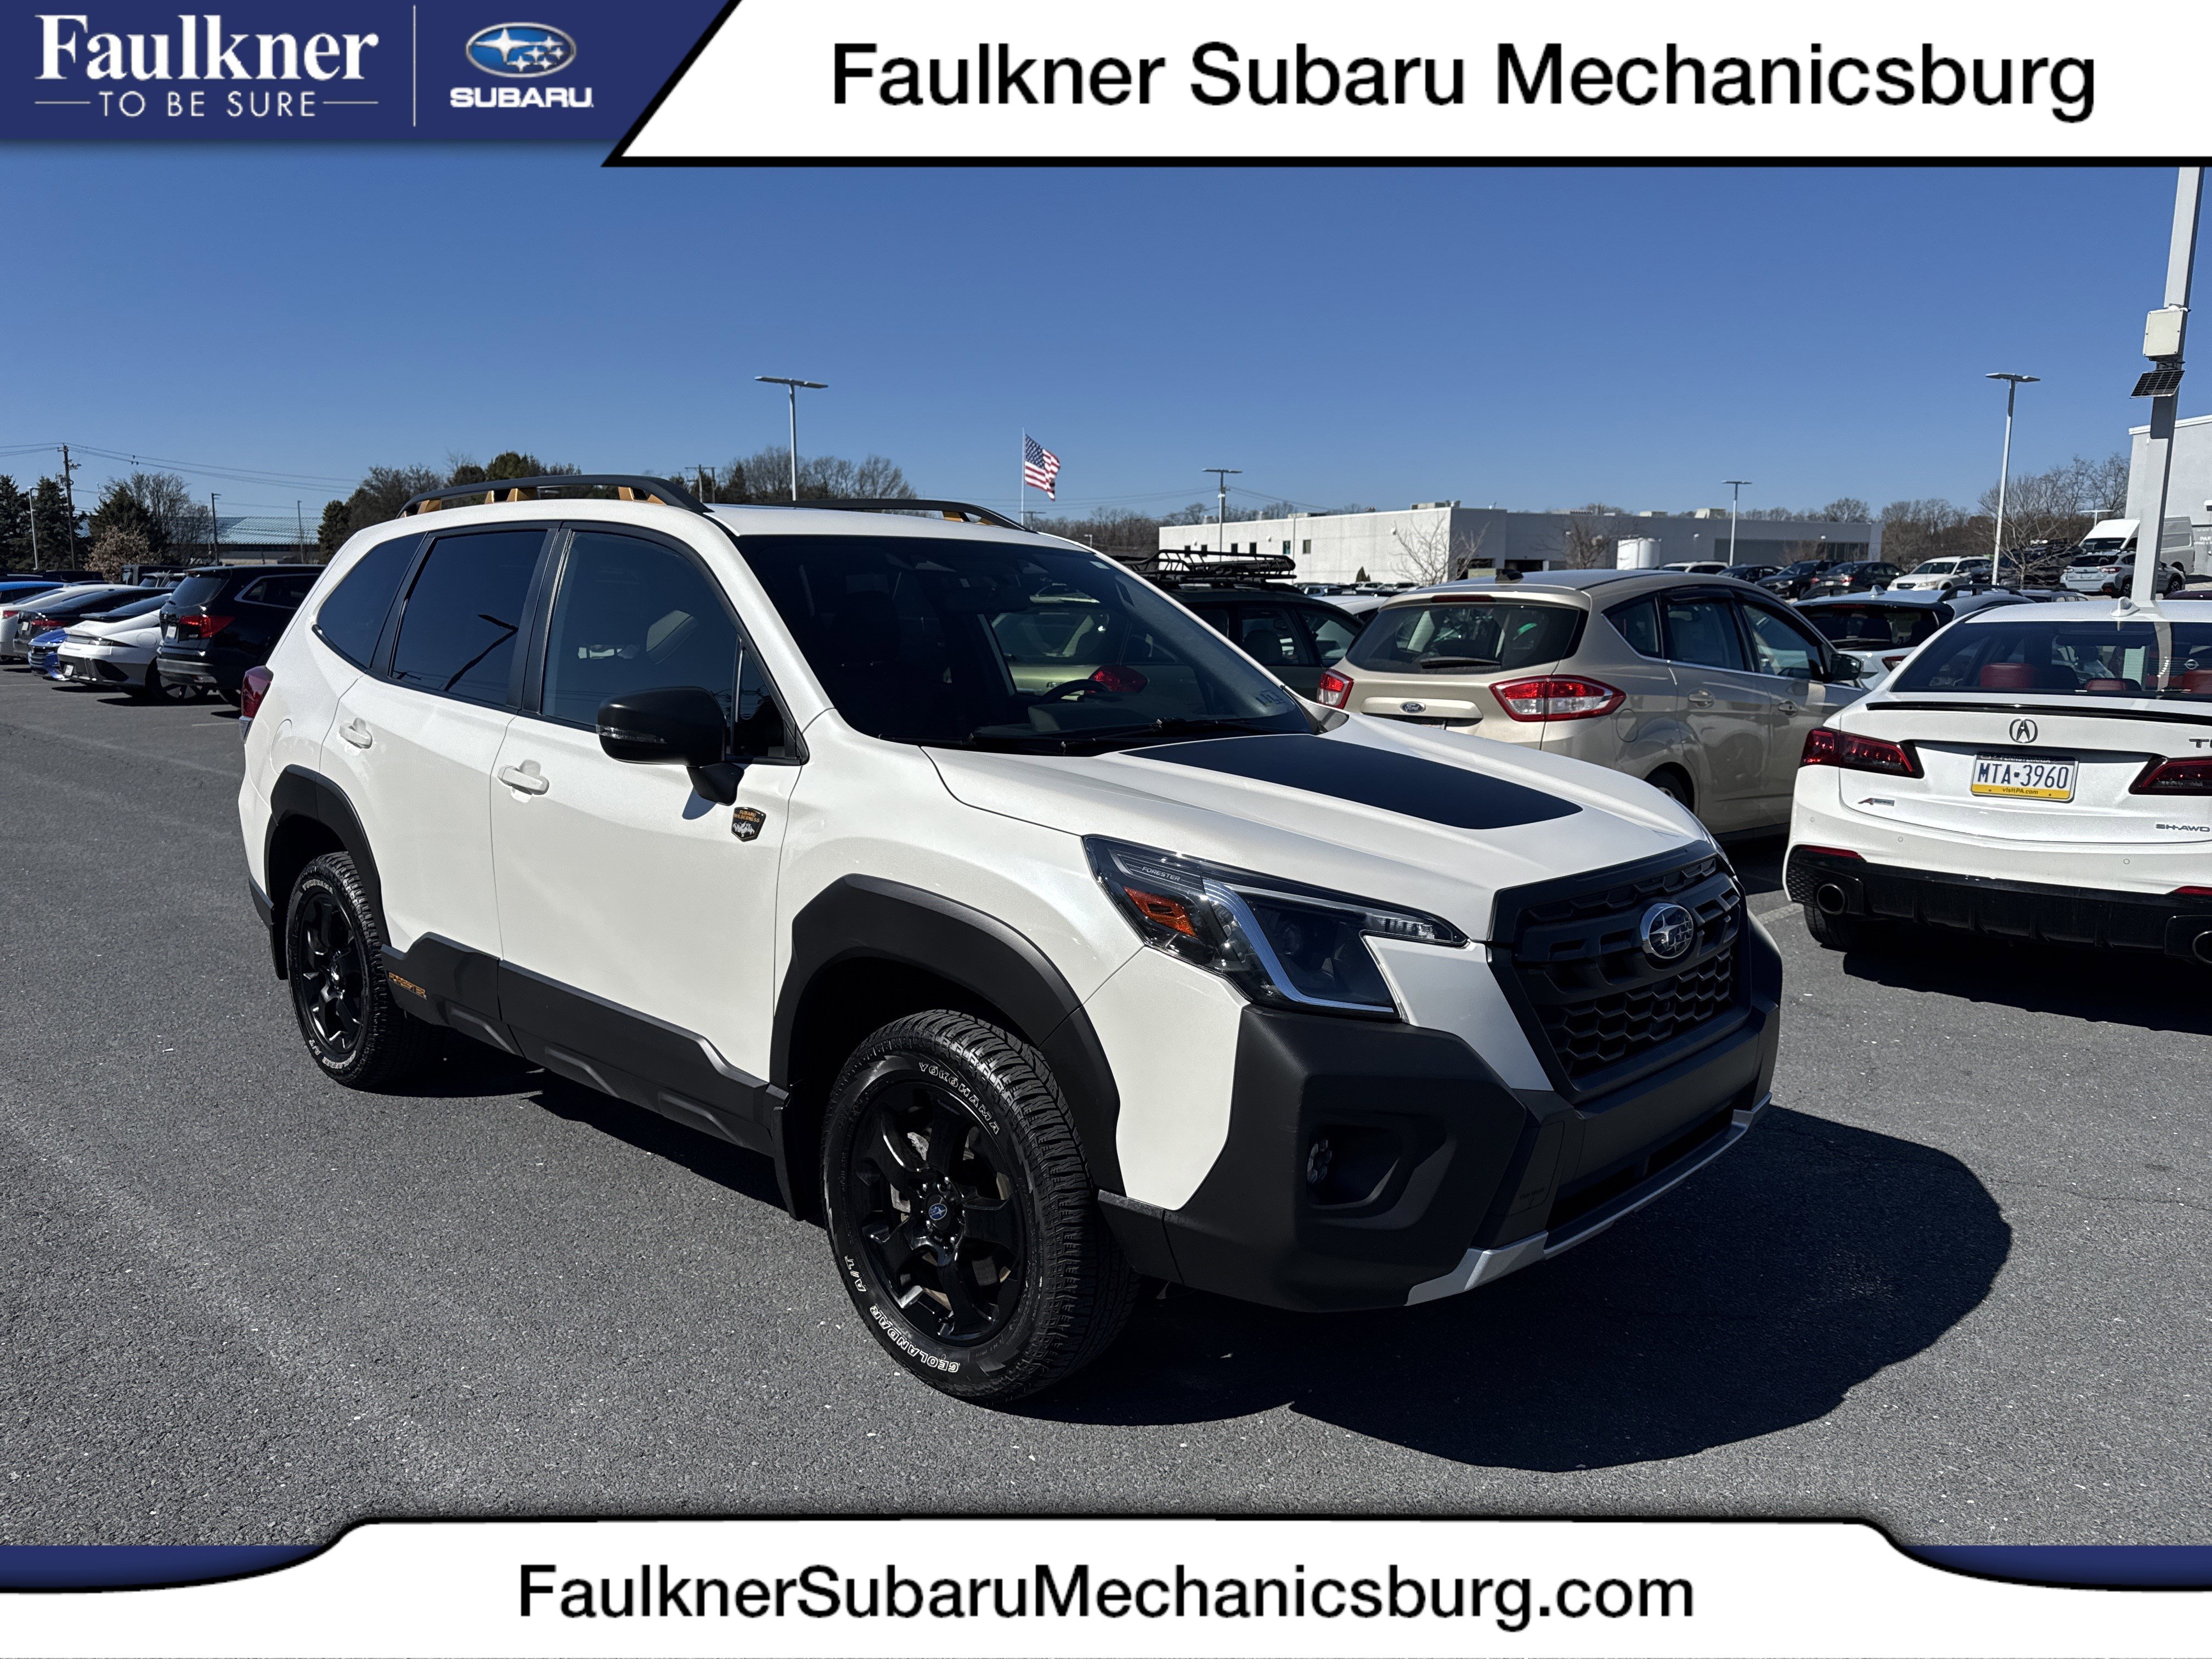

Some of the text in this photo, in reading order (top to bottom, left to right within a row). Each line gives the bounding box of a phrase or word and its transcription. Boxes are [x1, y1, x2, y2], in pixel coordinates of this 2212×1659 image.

[733, 814, 760, 823] WILDERNESS
[1142, 866, 1181, 881] FORESTER
[918, 1062, 1000, 1135] YOKOHAMA
[844, 1255, 960, 1373] GEOLANDAR A/T
